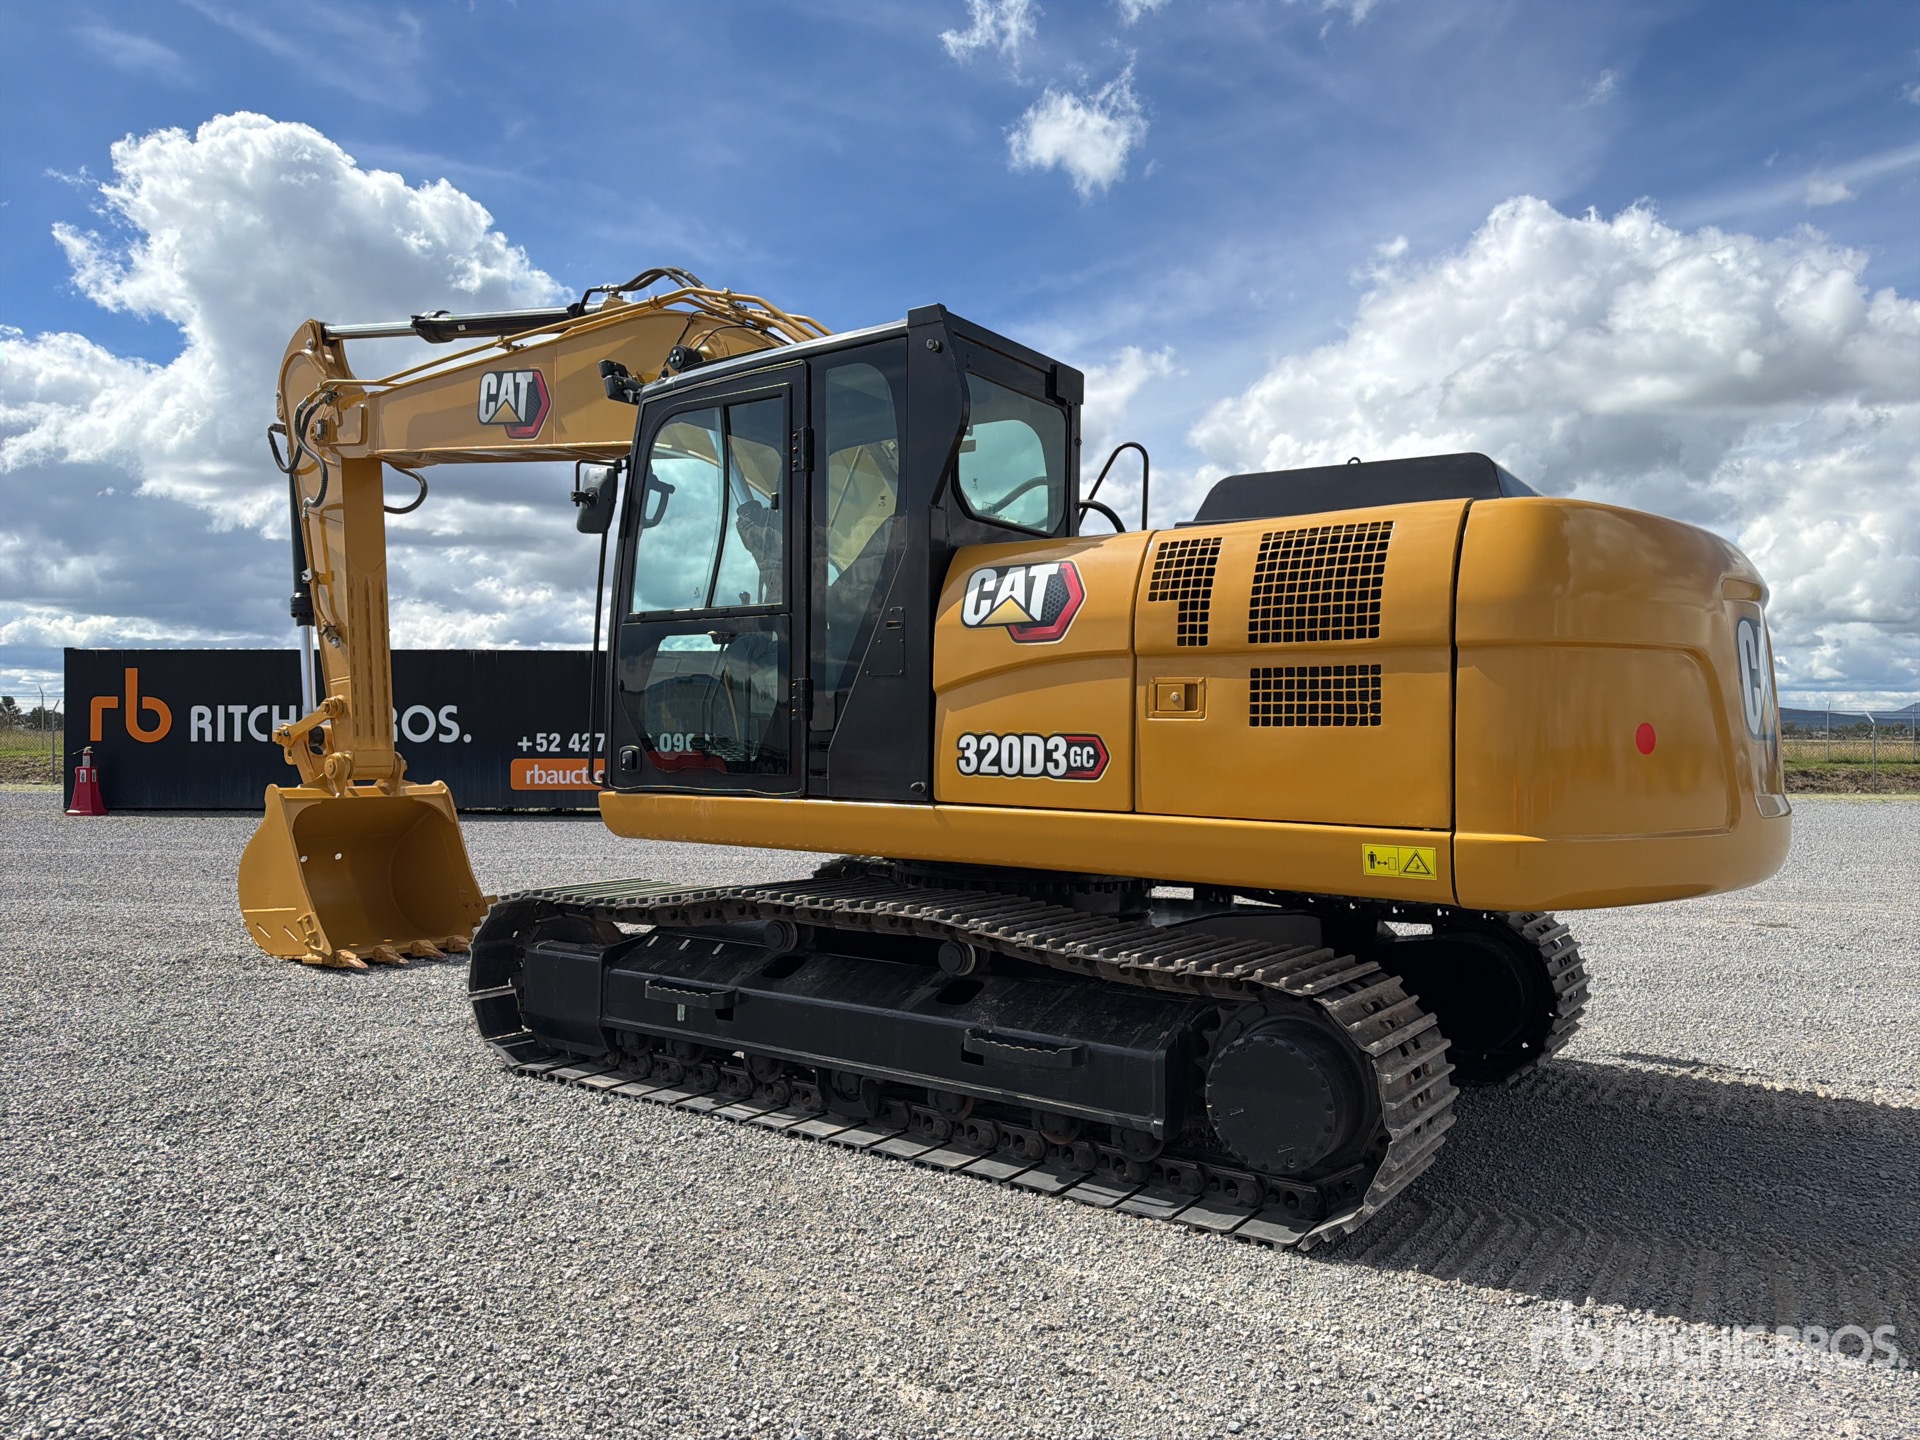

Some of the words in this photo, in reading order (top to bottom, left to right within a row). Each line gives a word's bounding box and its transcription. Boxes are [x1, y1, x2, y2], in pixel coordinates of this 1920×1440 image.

[479, 371, 534, 423] CAT
[962, 562, 1060, 626] CAT
[1737, 619, 1774, 736] CA
[89, 667, 173, 743] rb
[190, 704, 331, 742] RITCH
[517, 732, 561, 752] +52
[568, 732, 606, 752] 427
[957, 733, 1068, 778] 320D3
[1069, 745, 1096, 769] GC
